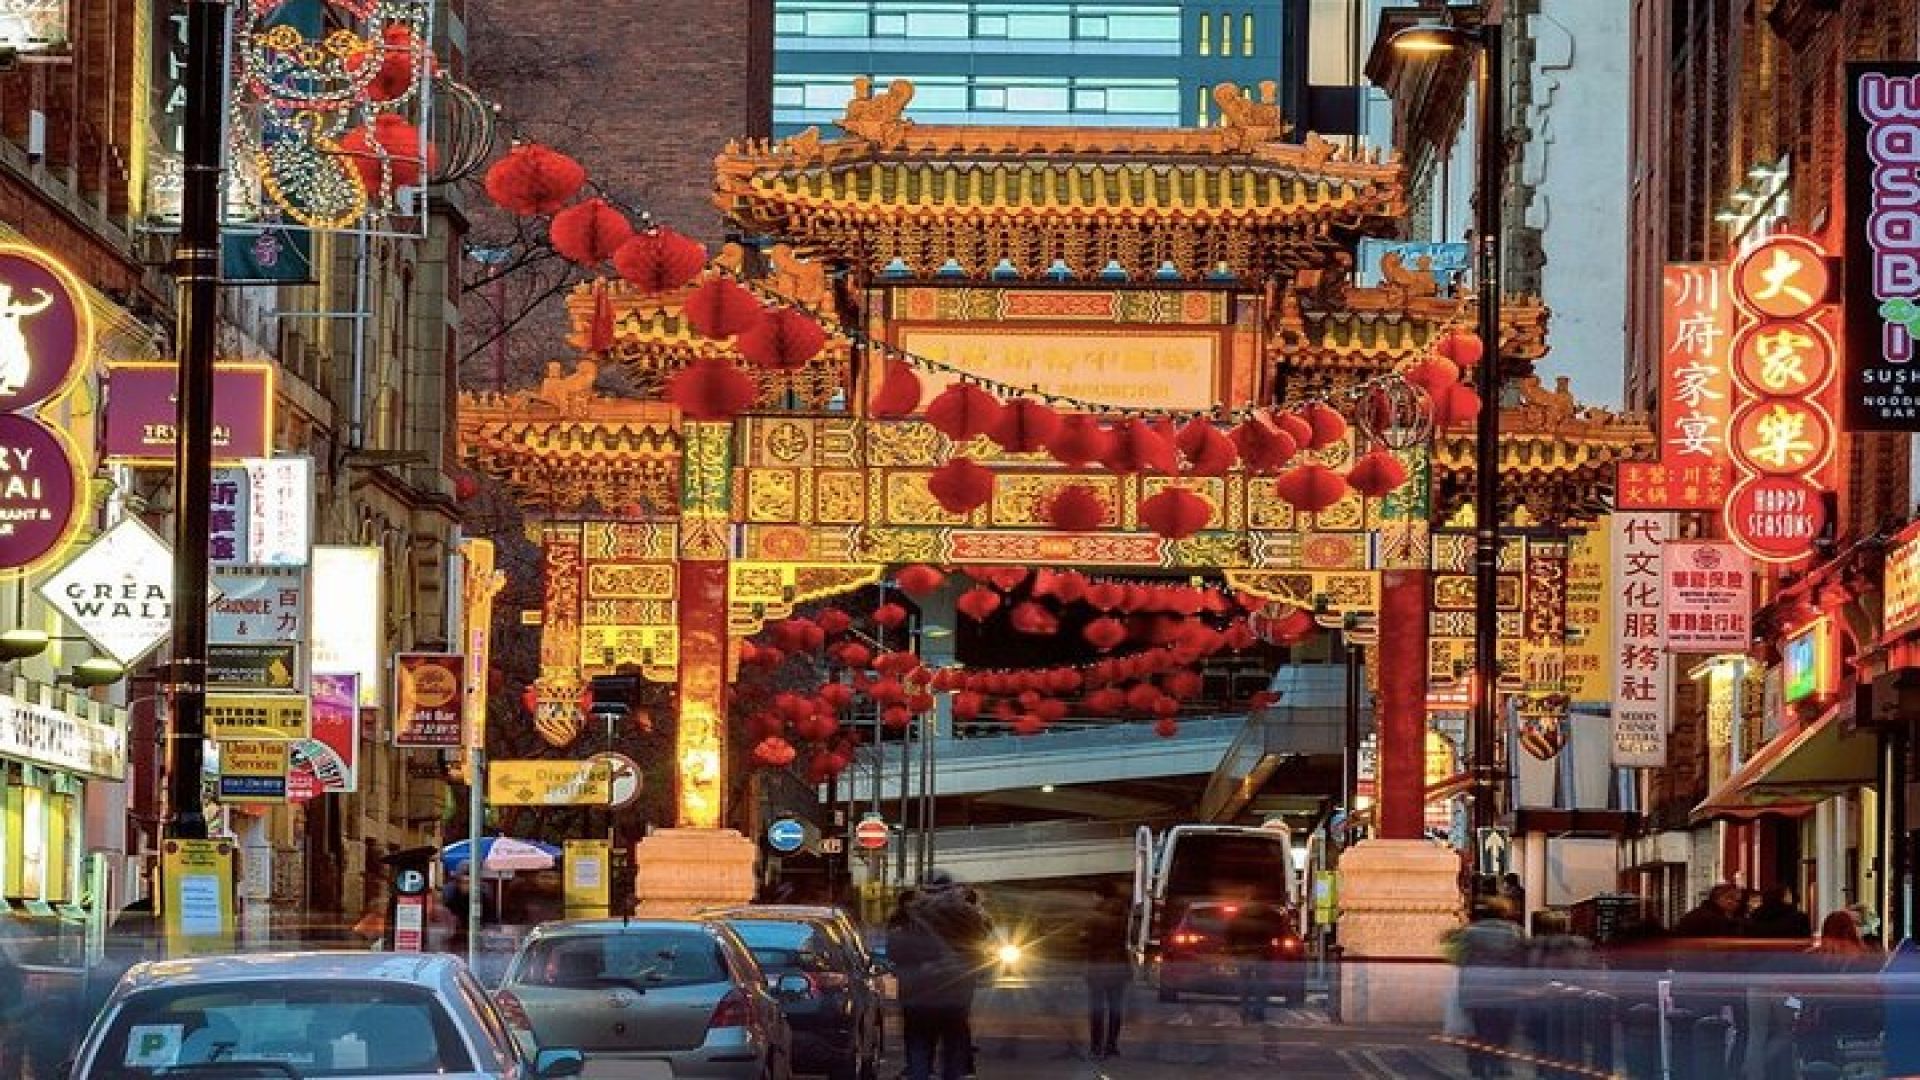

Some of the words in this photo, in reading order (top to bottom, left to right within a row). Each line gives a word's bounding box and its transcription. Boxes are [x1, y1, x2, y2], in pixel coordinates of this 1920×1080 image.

[1669, 266, 1724, 456] 川府家宴
[1750, 249, 1814, 466] 大家樂
[1754, 489, 1806, 513] HAPPY
[1749, 513, 1813, 538] SEASONS
[66, 582, 165, 599] GREA
[1621, 519, 1661, 700] 代文化服務社
[205, 708, 266, 717] ESTERN
[405, 871, 421, 892] P
[140, 1034, 167, 1056] P
